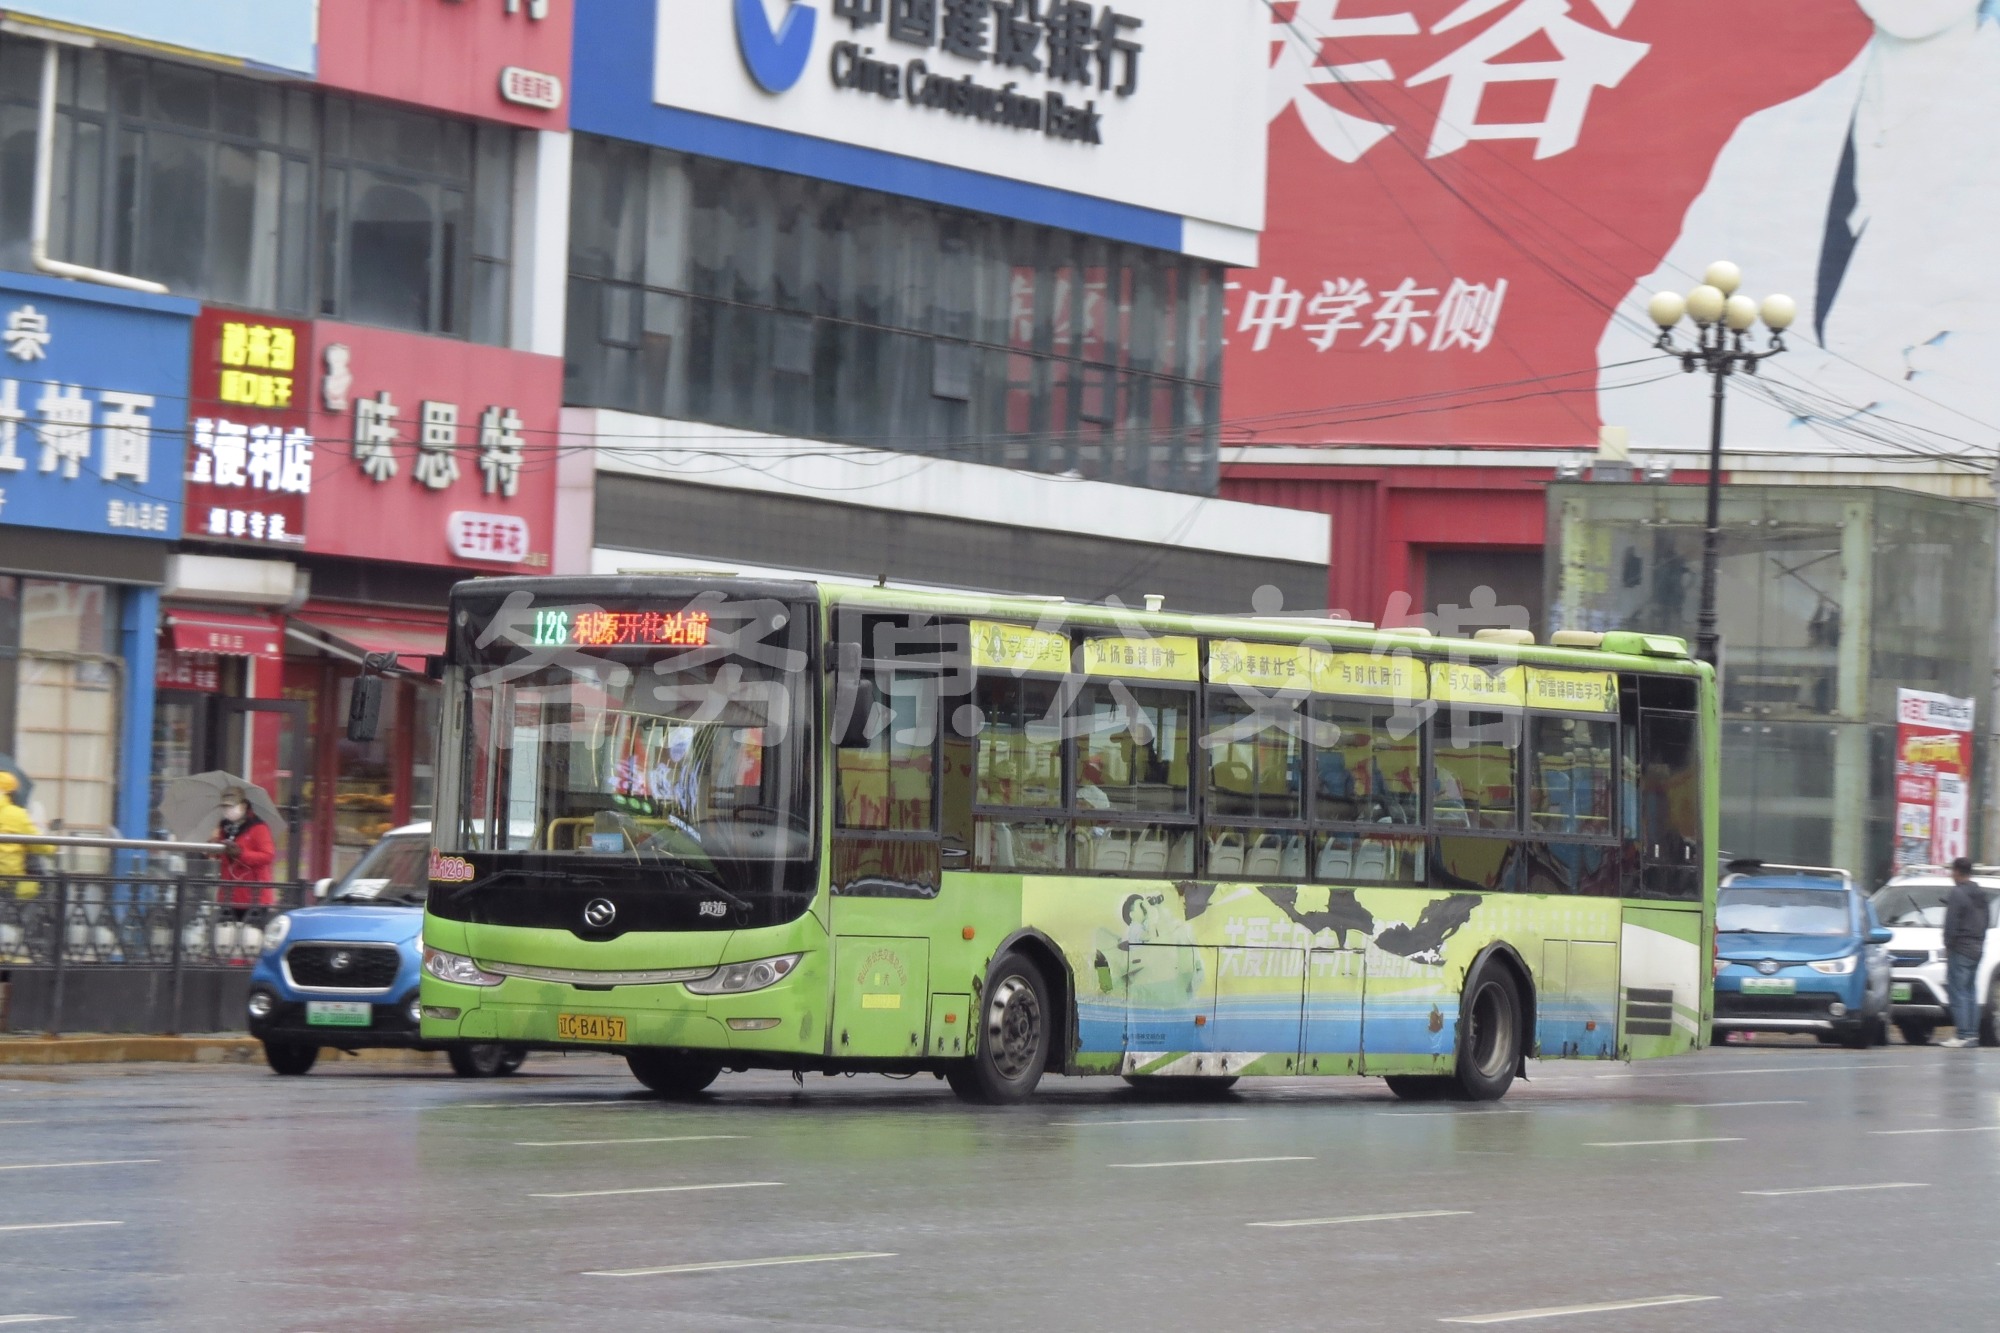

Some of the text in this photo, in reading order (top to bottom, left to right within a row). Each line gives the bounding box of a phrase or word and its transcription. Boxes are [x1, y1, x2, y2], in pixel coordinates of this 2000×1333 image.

[831, 40, 1103, 146] China Construction Bank
[1223, 276, 1518, 353] 中学东侧
[353, 390, 527, 497] 味思特
[534, 610, 710, 646] 126 利源开往站前
[1096, 643, 1176, 668] 弘扬雷锋精神
[1220, 653, 1296, 677] 爱心奉献社会
[1342, 665, 1403, 686] 与时代同行
[1537, 677, 1603, 701] 向雷锋同志学习
[699, 900, 728, 917] 黄海
